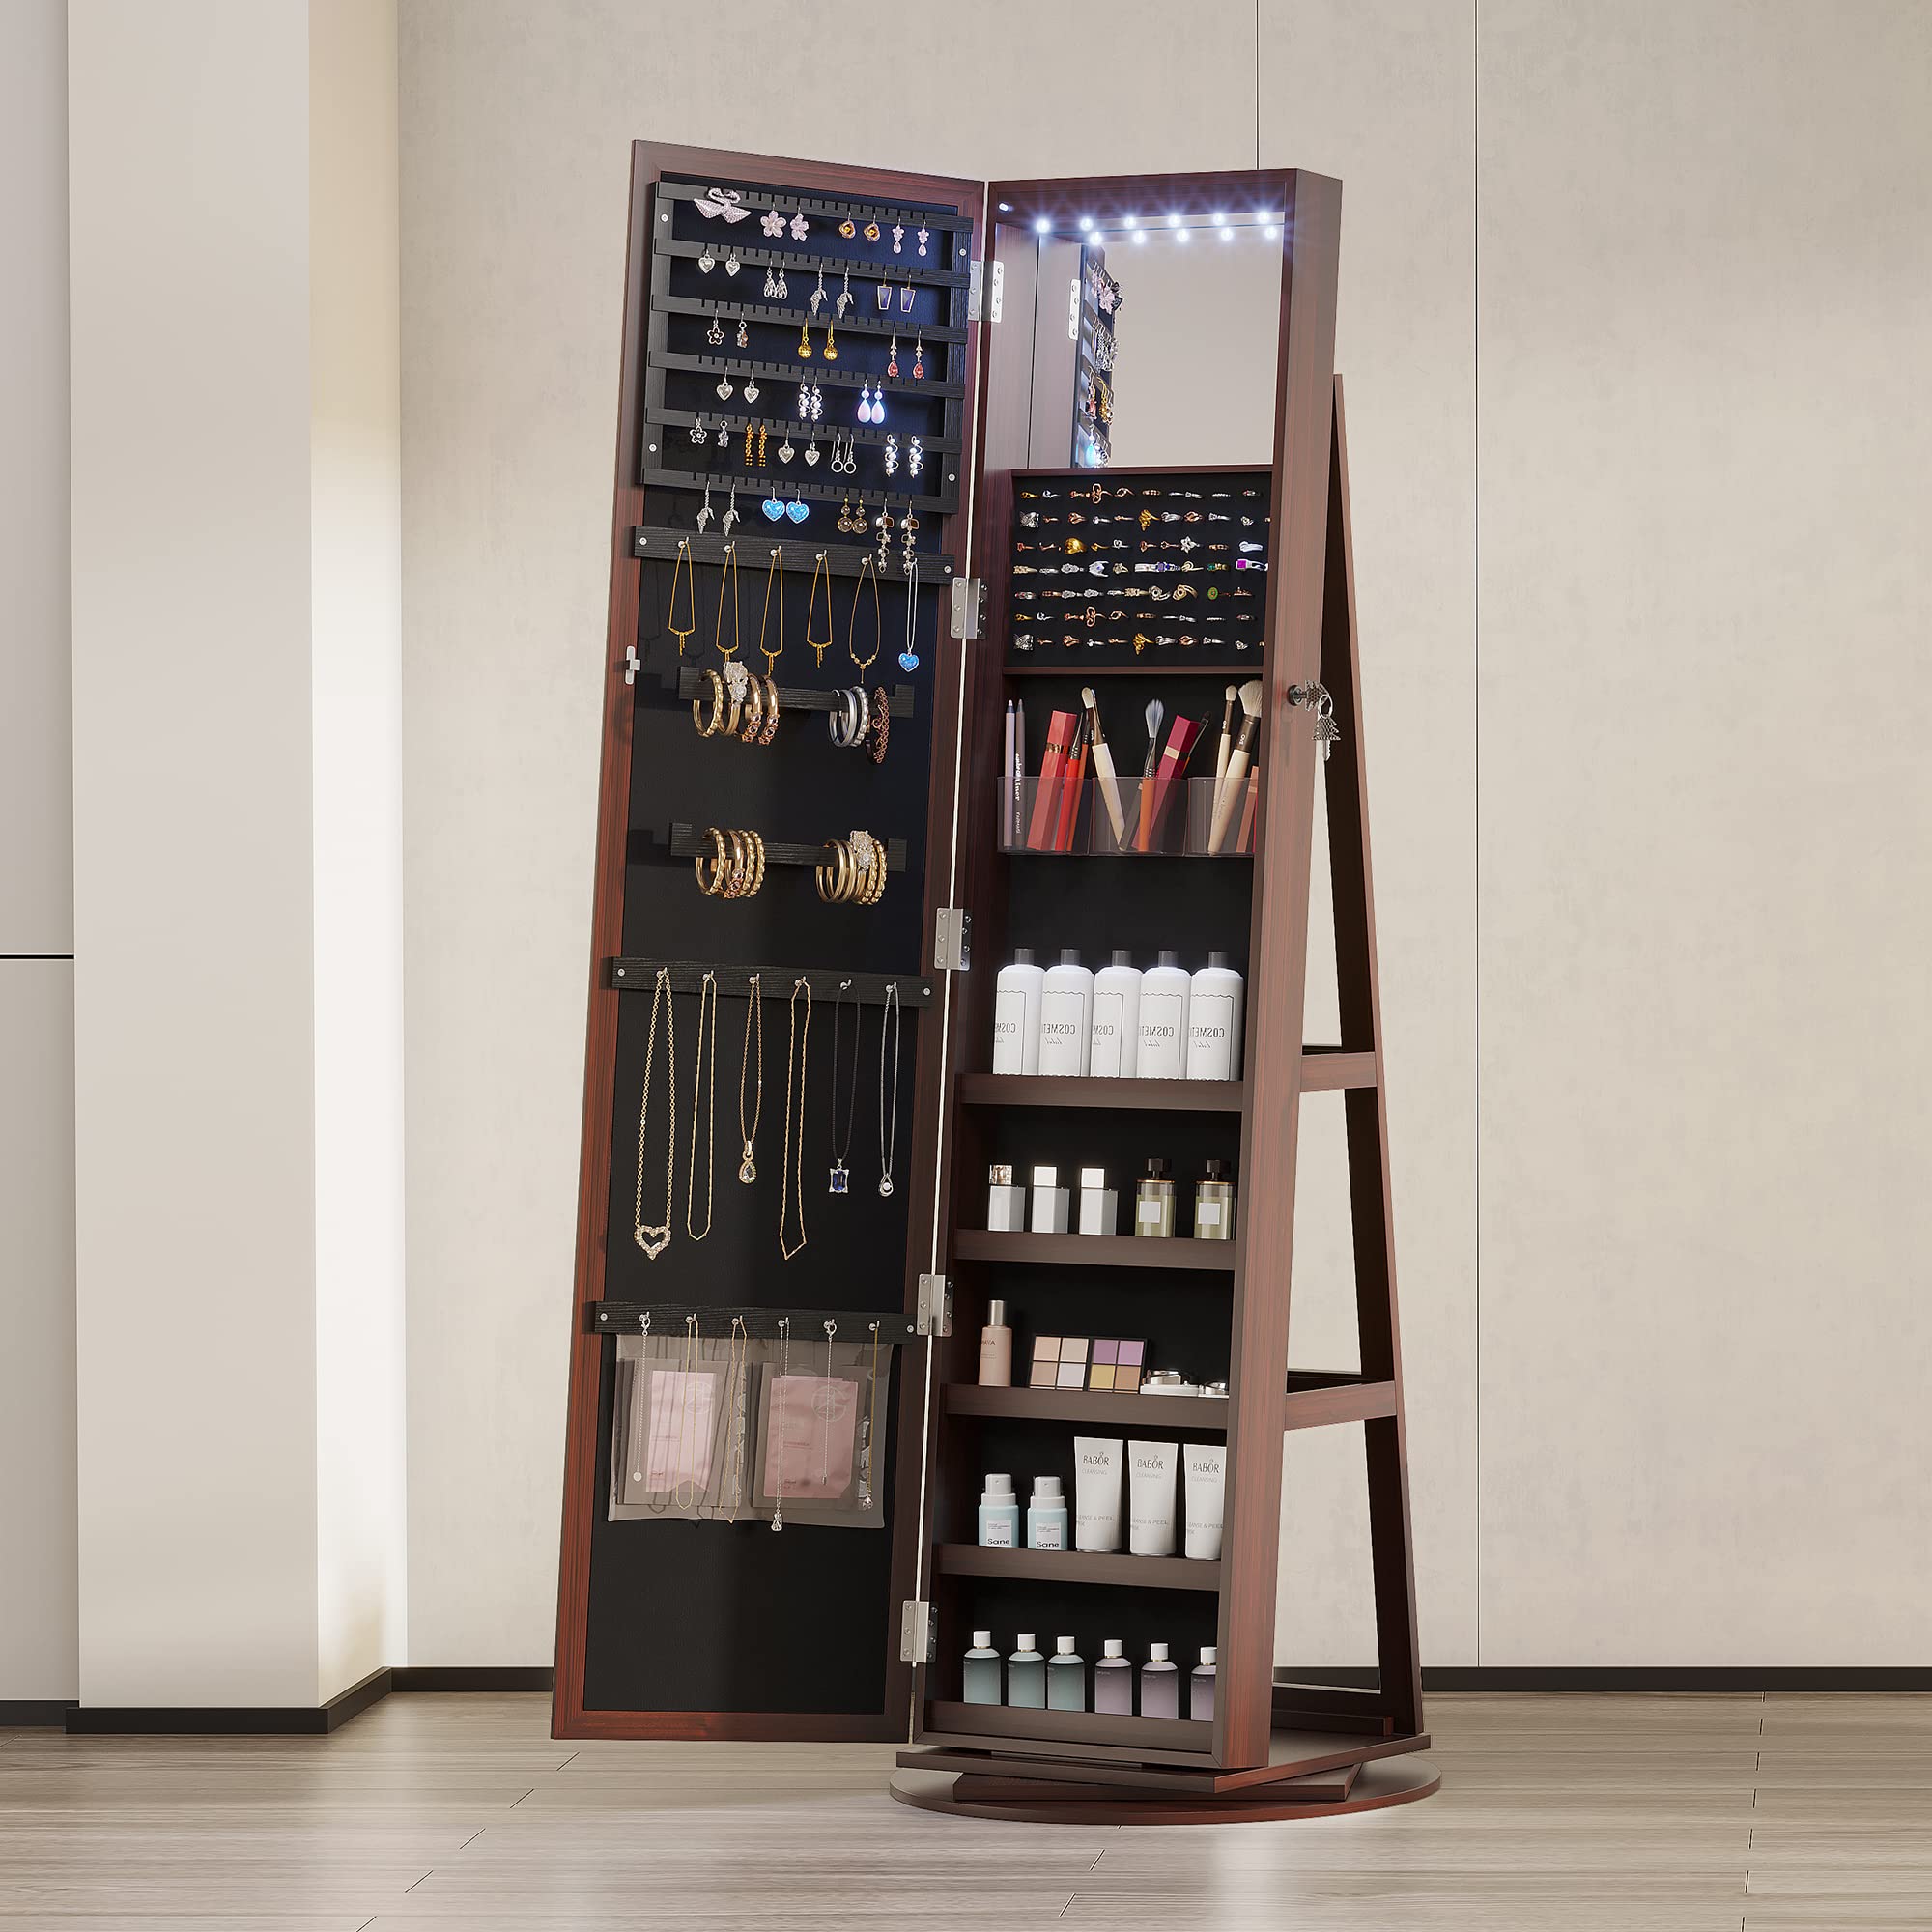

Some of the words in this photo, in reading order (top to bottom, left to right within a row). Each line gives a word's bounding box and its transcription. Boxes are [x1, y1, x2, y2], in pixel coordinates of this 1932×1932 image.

[1083, 1452, 1110, 1466] BABOR
[1137, 1455, 1164, 1470] BABOR
[1193, 1459, 1220, 1474] BABOR
